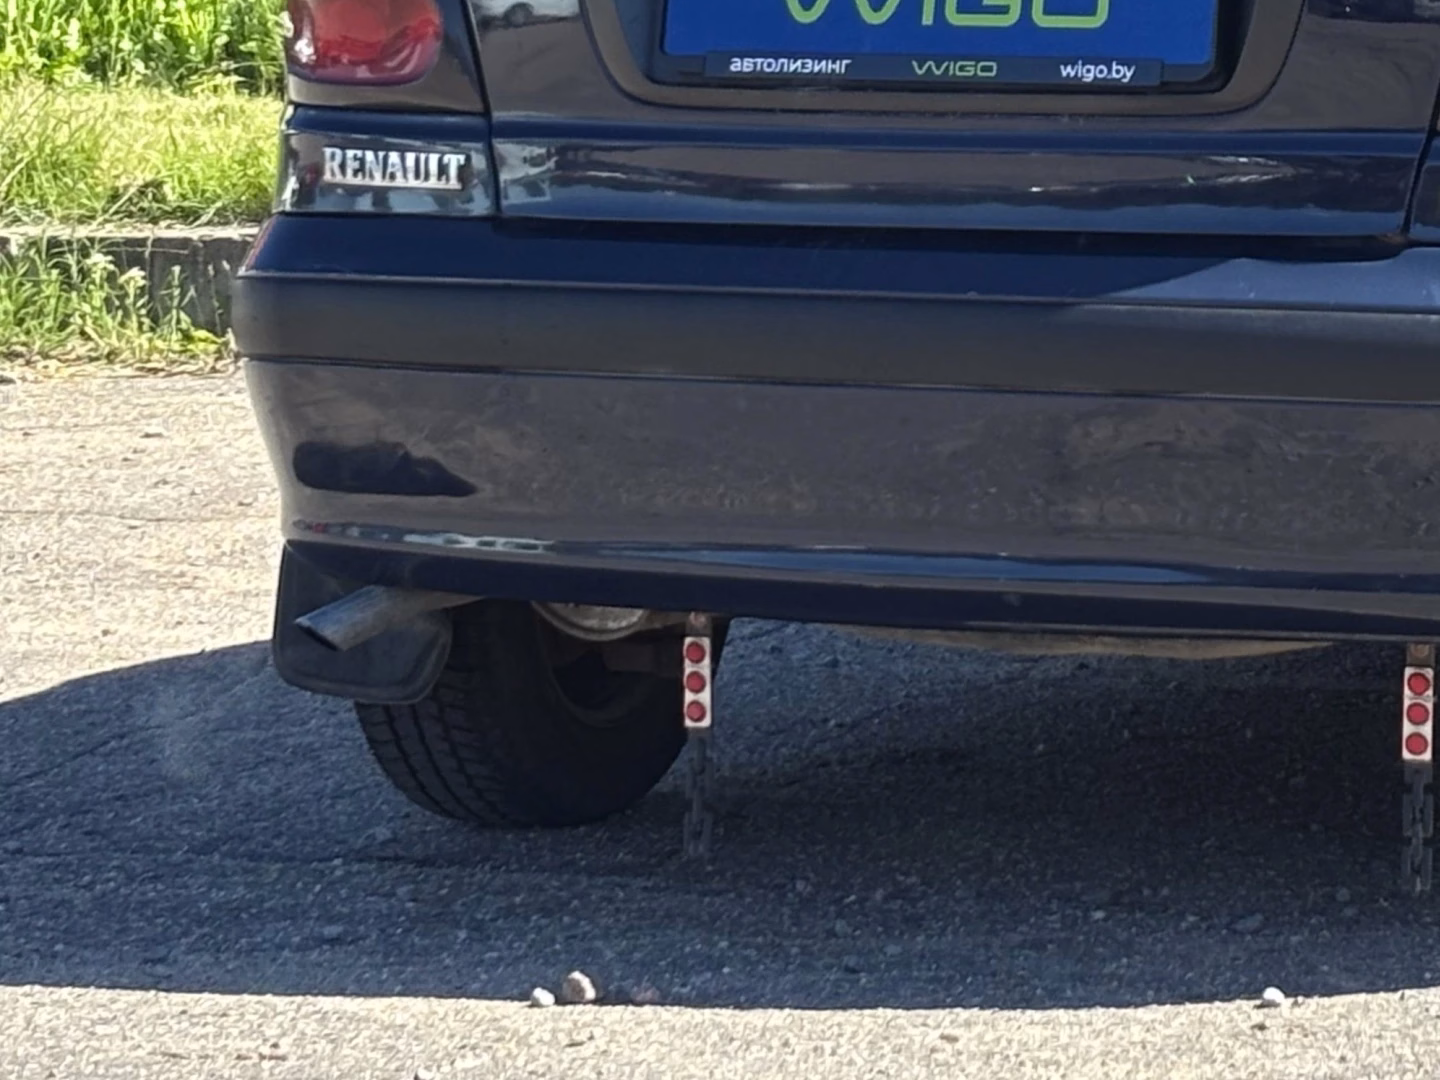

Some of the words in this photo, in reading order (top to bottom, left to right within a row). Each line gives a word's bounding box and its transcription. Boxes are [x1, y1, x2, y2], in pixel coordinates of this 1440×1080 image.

[730, 56, 852, 75] автолизинг
[911, 60, 997, 77] WIGO
[1059, 62, 1136, 83] wigo.by
[323, 147, 466, 190] RENAULT
